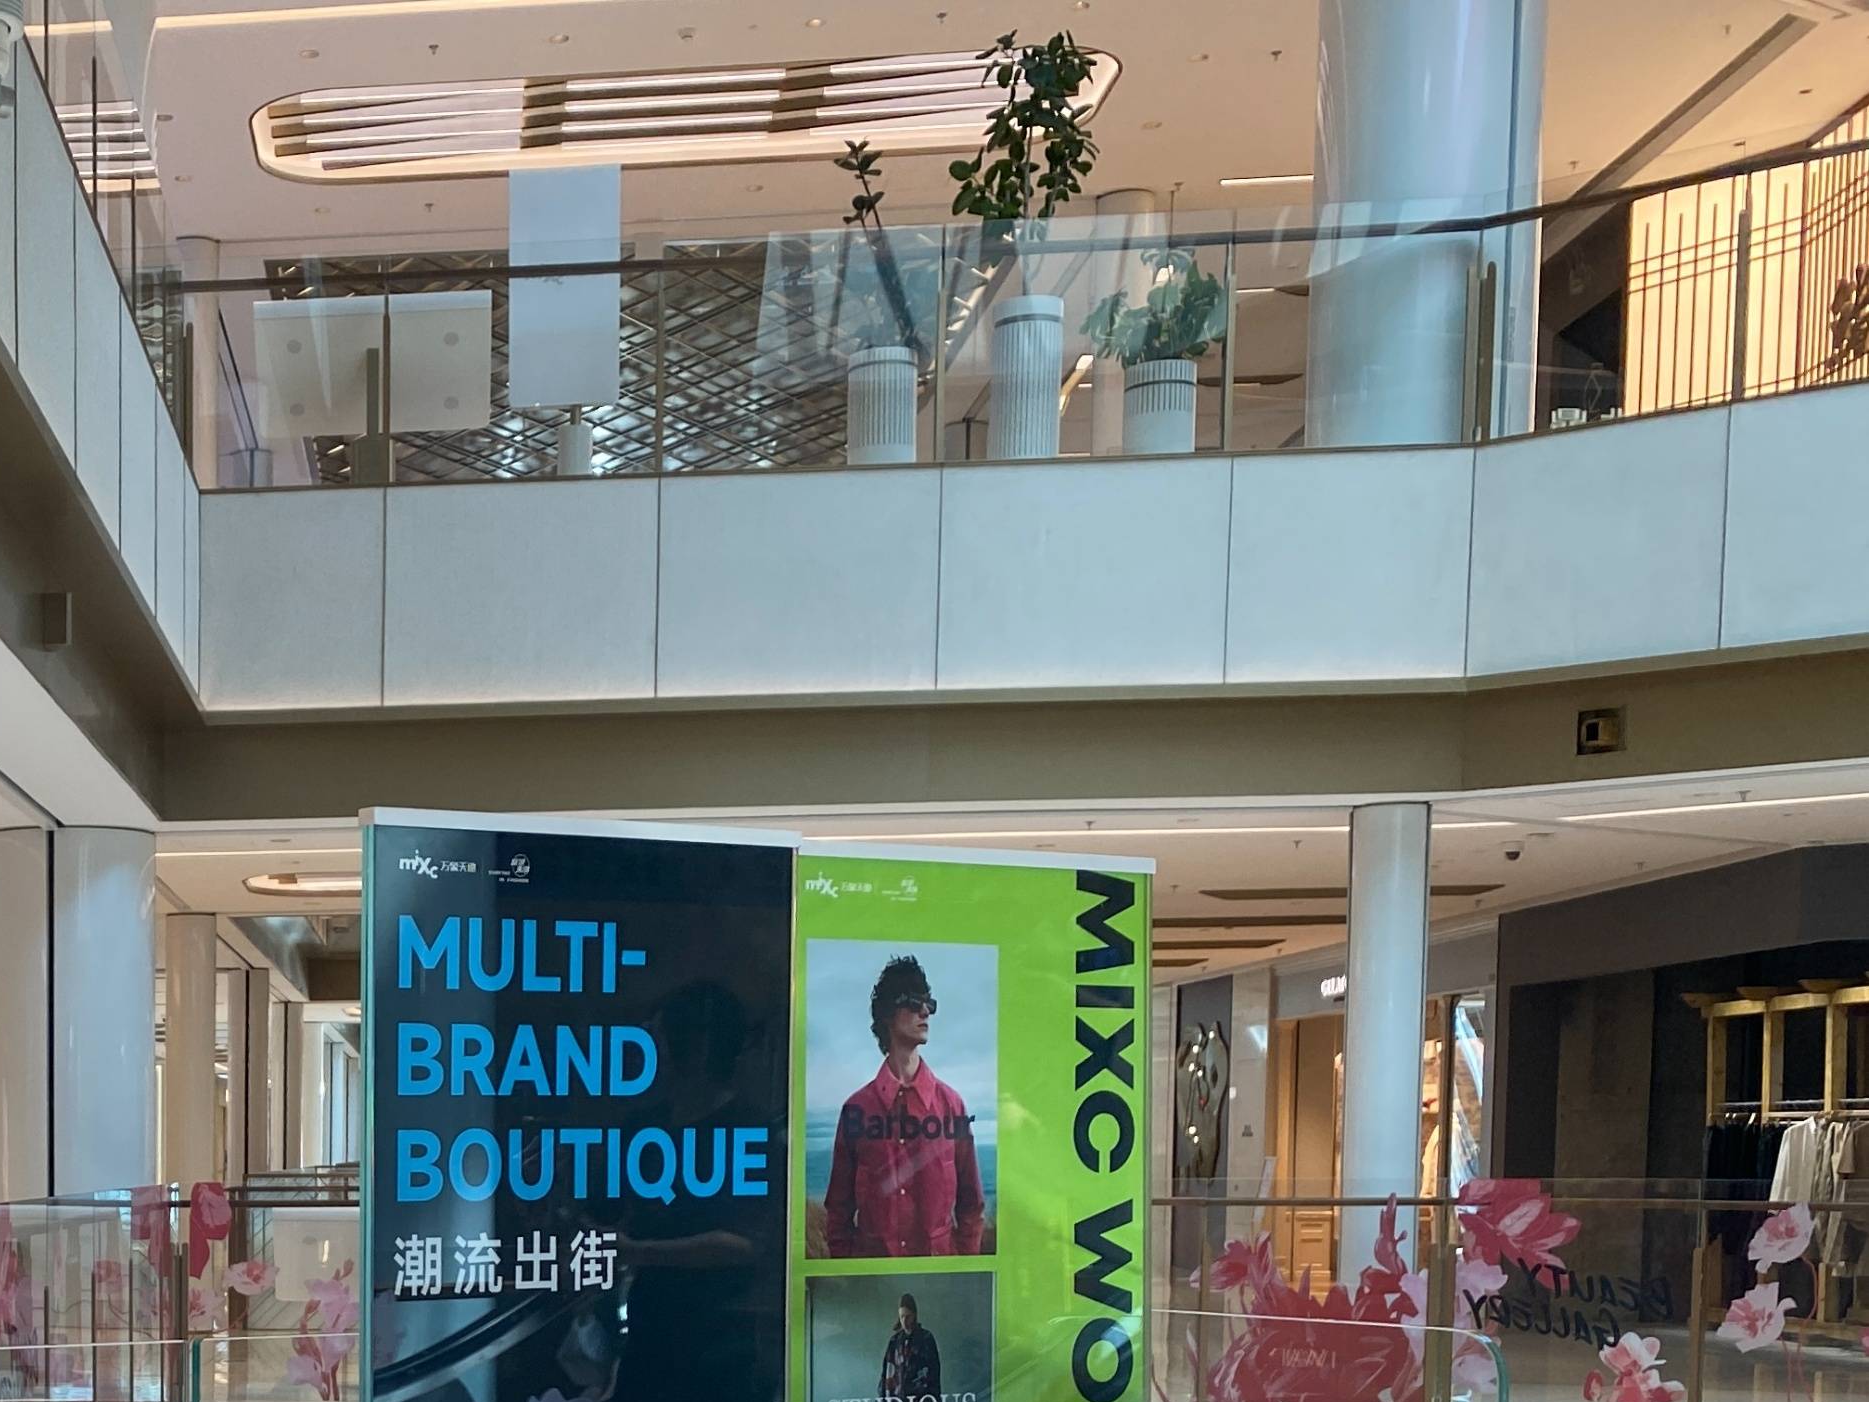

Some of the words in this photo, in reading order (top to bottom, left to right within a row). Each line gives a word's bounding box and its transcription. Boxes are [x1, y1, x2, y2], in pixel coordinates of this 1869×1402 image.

[397, 914, 647, 993] MULTI-
[397, 1022, 658, 1096] BRAND
[1073, 868, 1136, 1174] MIXC
[843, 1103, 976, 1141] Barbour
[397, 1126, 770, 1206] BOUTIQUE
[393, 1229, 619, 1298] 潮流出街
